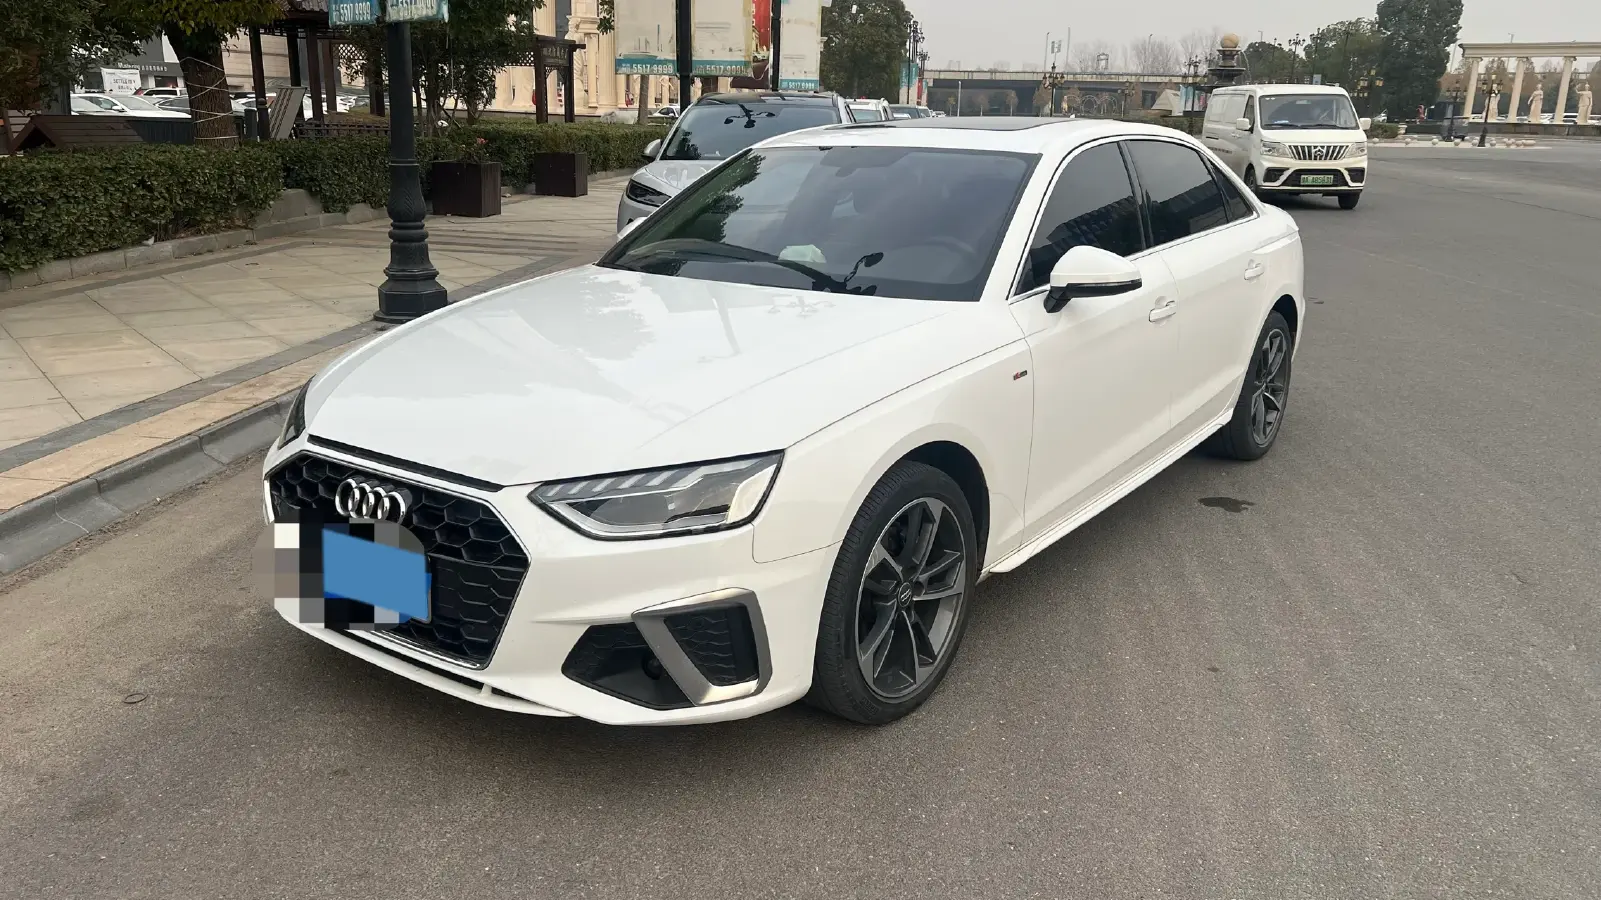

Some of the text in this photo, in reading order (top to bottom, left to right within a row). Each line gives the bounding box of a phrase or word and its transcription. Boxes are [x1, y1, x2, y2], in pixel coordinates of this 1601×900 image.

[340, 4, 353, 21] 5517
[355, 2, 371, 21] 9999
[632, 64, 650, 73] 5517
[652, 64, 673, 74] 9999
